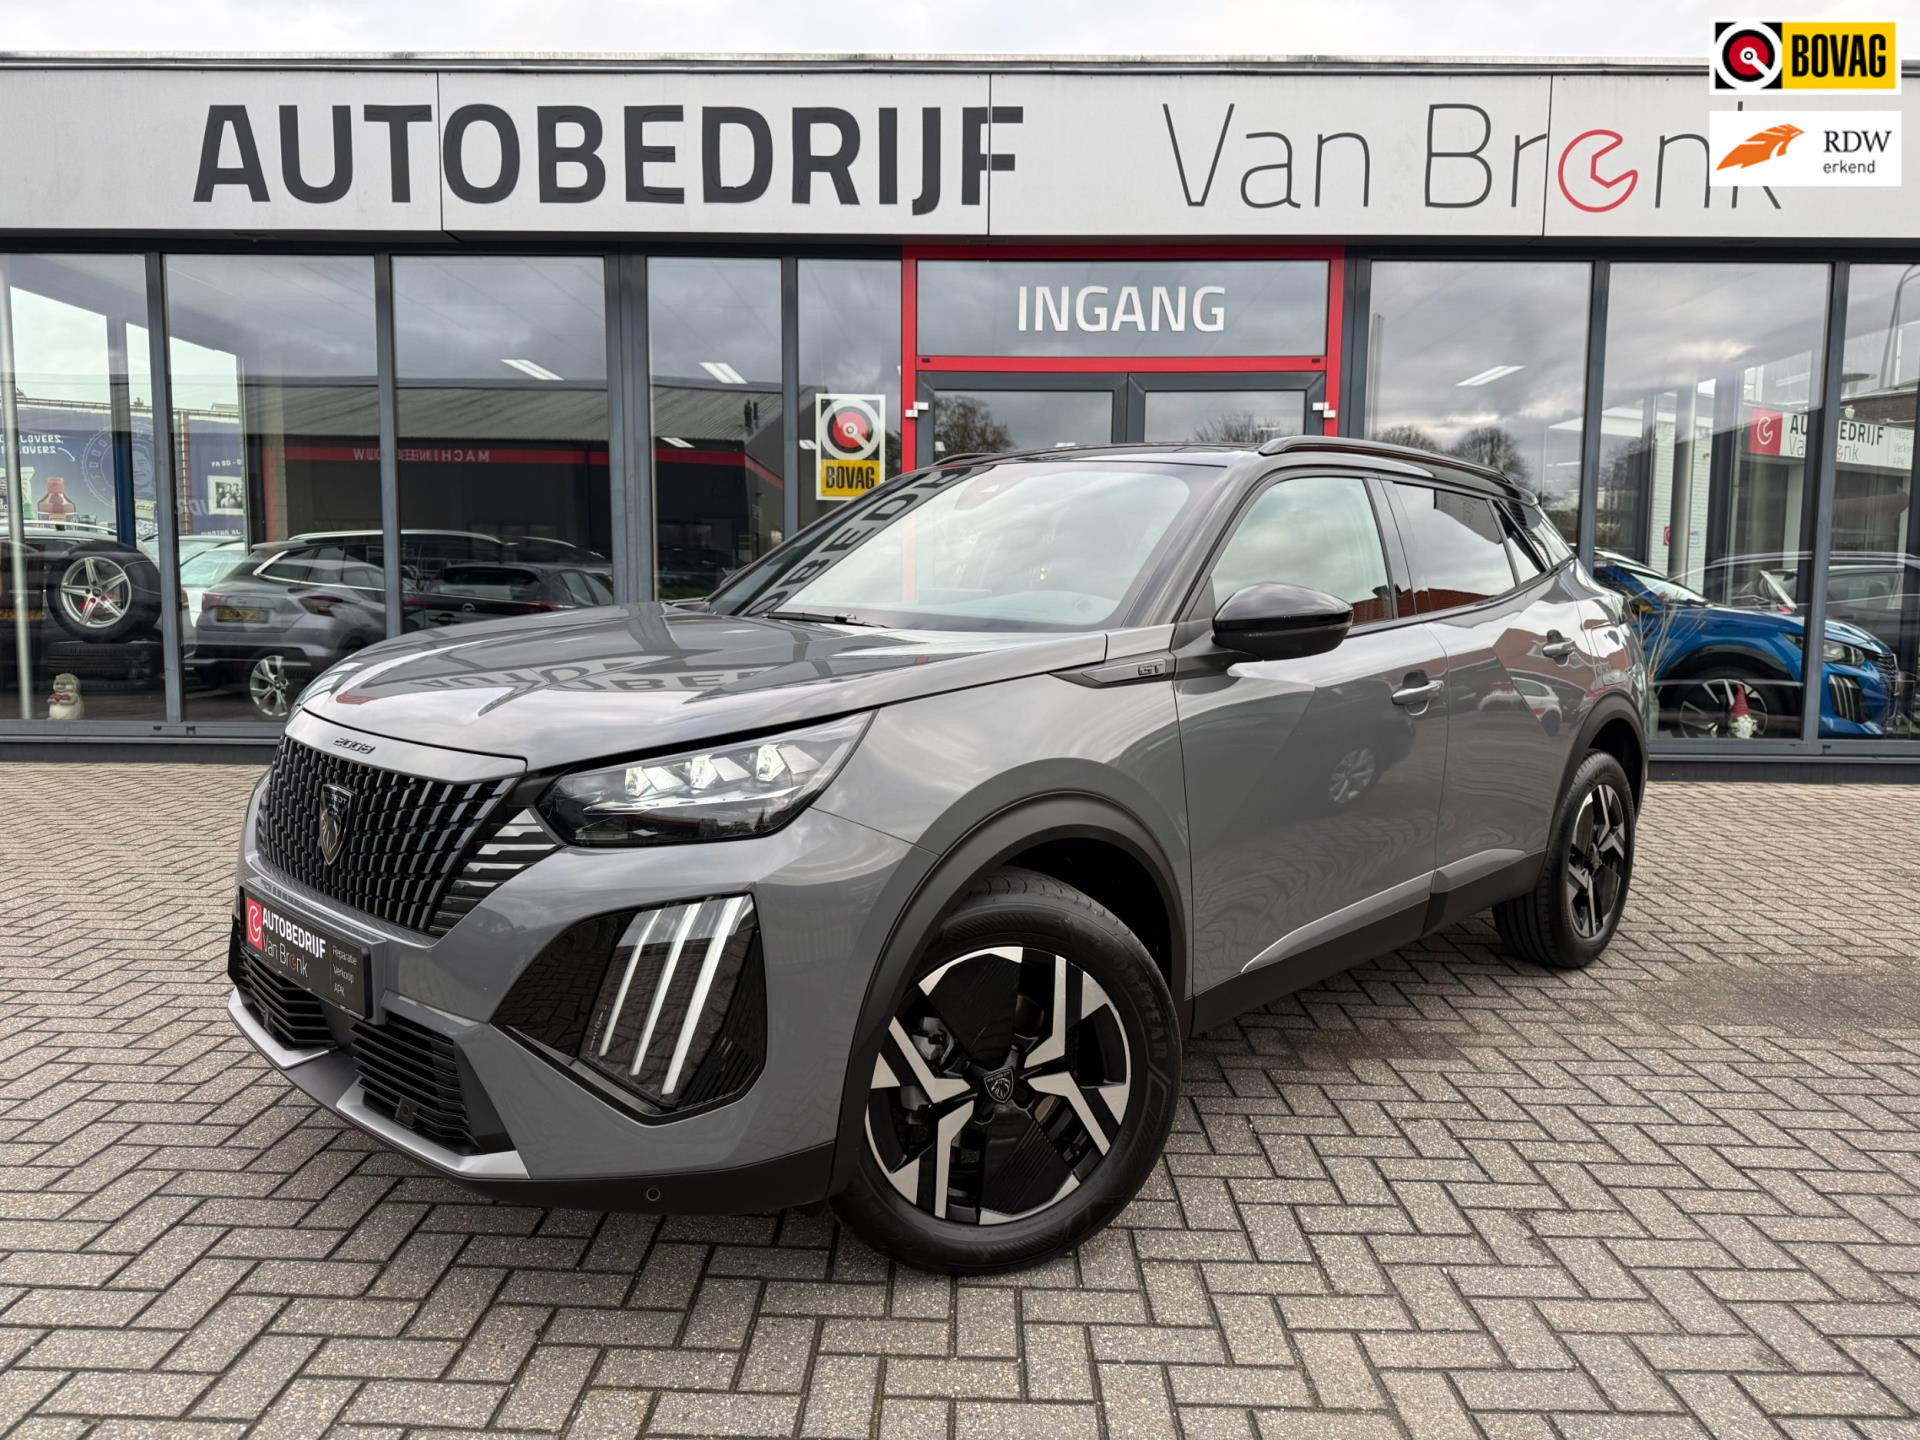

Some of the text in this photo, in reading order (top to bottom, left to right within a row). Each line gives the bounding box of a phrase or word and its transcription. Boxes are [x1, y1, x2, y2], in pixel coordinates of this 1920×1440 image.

[194, 104, 1023, 215] AUTOBEDRIJF
[1163, 104, 1369, 208] Van
[1018, 286, 1225, 332] INGANG
[1790, 415, 1884, 445] AUEDRIJF
[825, 465, 875, 489] BOVAG
[333, 738, 376, 754] 2008
[262, 907, 326, 959] AUTOBEDRIJF
[262, 931, 279, 959] Van
